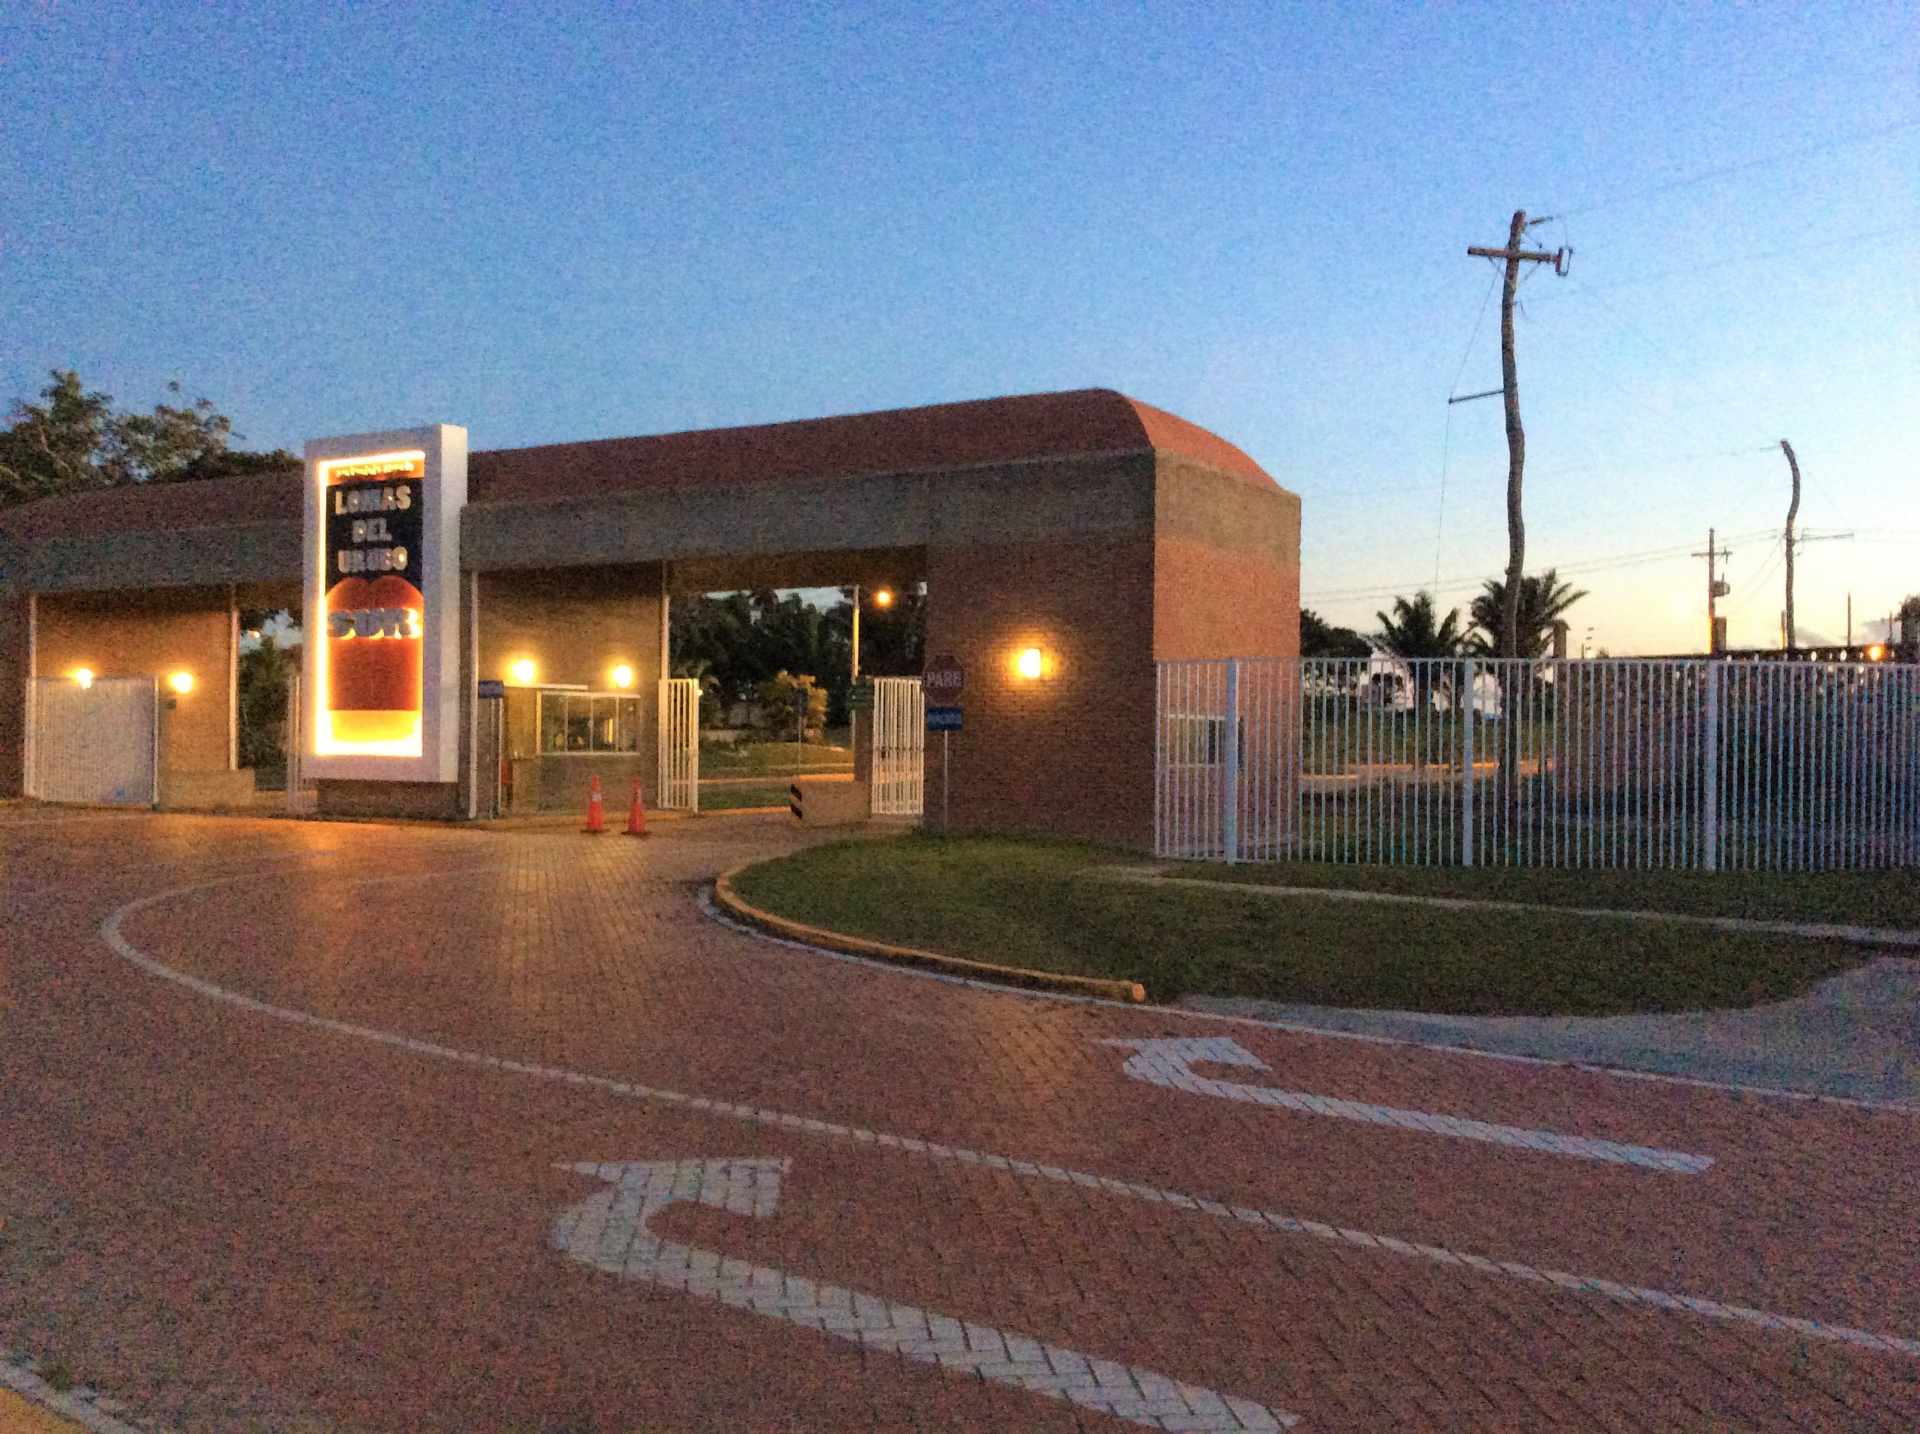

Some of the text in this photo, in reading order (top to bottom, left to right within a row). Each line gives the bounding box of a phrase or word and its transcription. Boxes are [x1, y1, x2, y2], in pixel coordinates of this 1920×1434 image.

[335, 485, 411, 515] LOMAS
[352, 518, 392, 542] DEL
[926, 671, 962, 688] PARE
